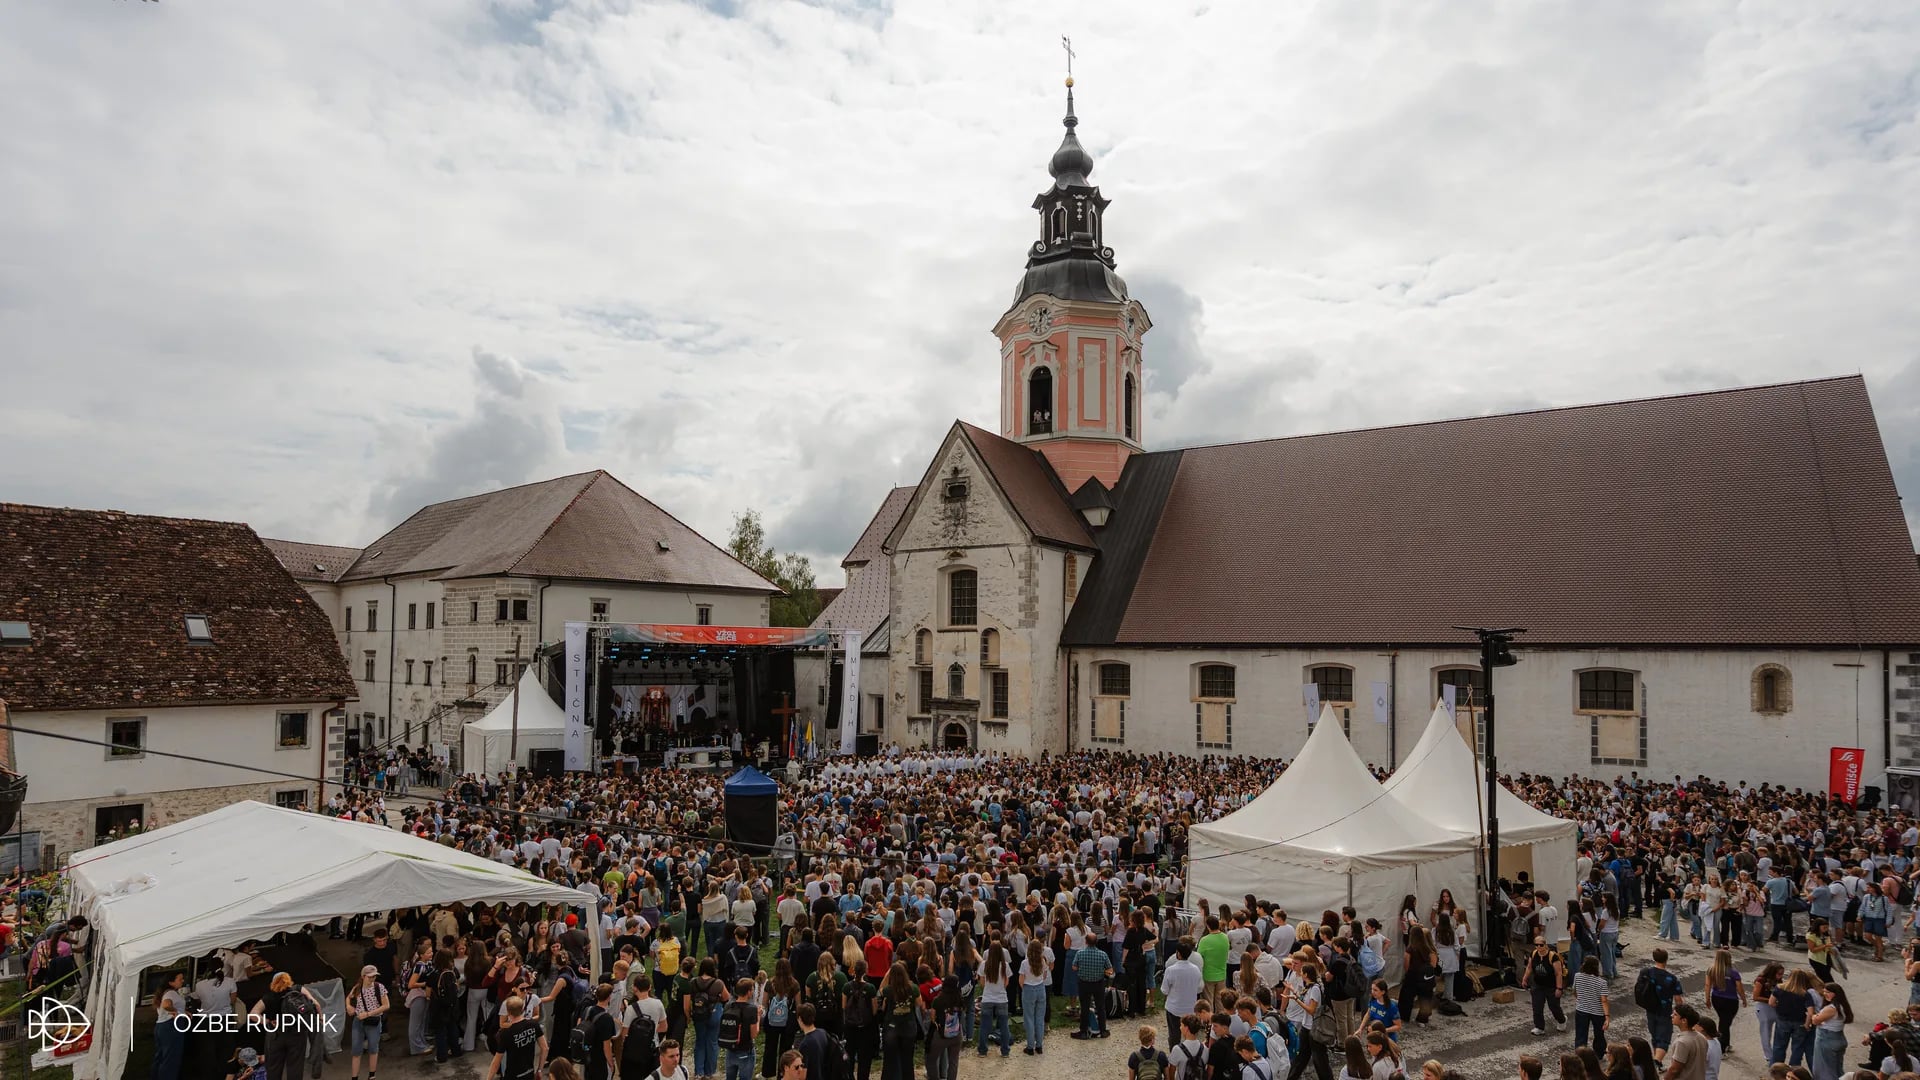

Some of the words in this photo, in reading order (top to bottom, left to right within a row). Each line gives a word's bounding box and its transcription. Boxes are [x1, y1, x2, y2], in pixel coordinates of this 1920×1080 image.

[572, 654, 580, 738] STIČNA
[848, 657, 857, 727] MLADIH
[1845, 763, 1858, 801] ognjišče
